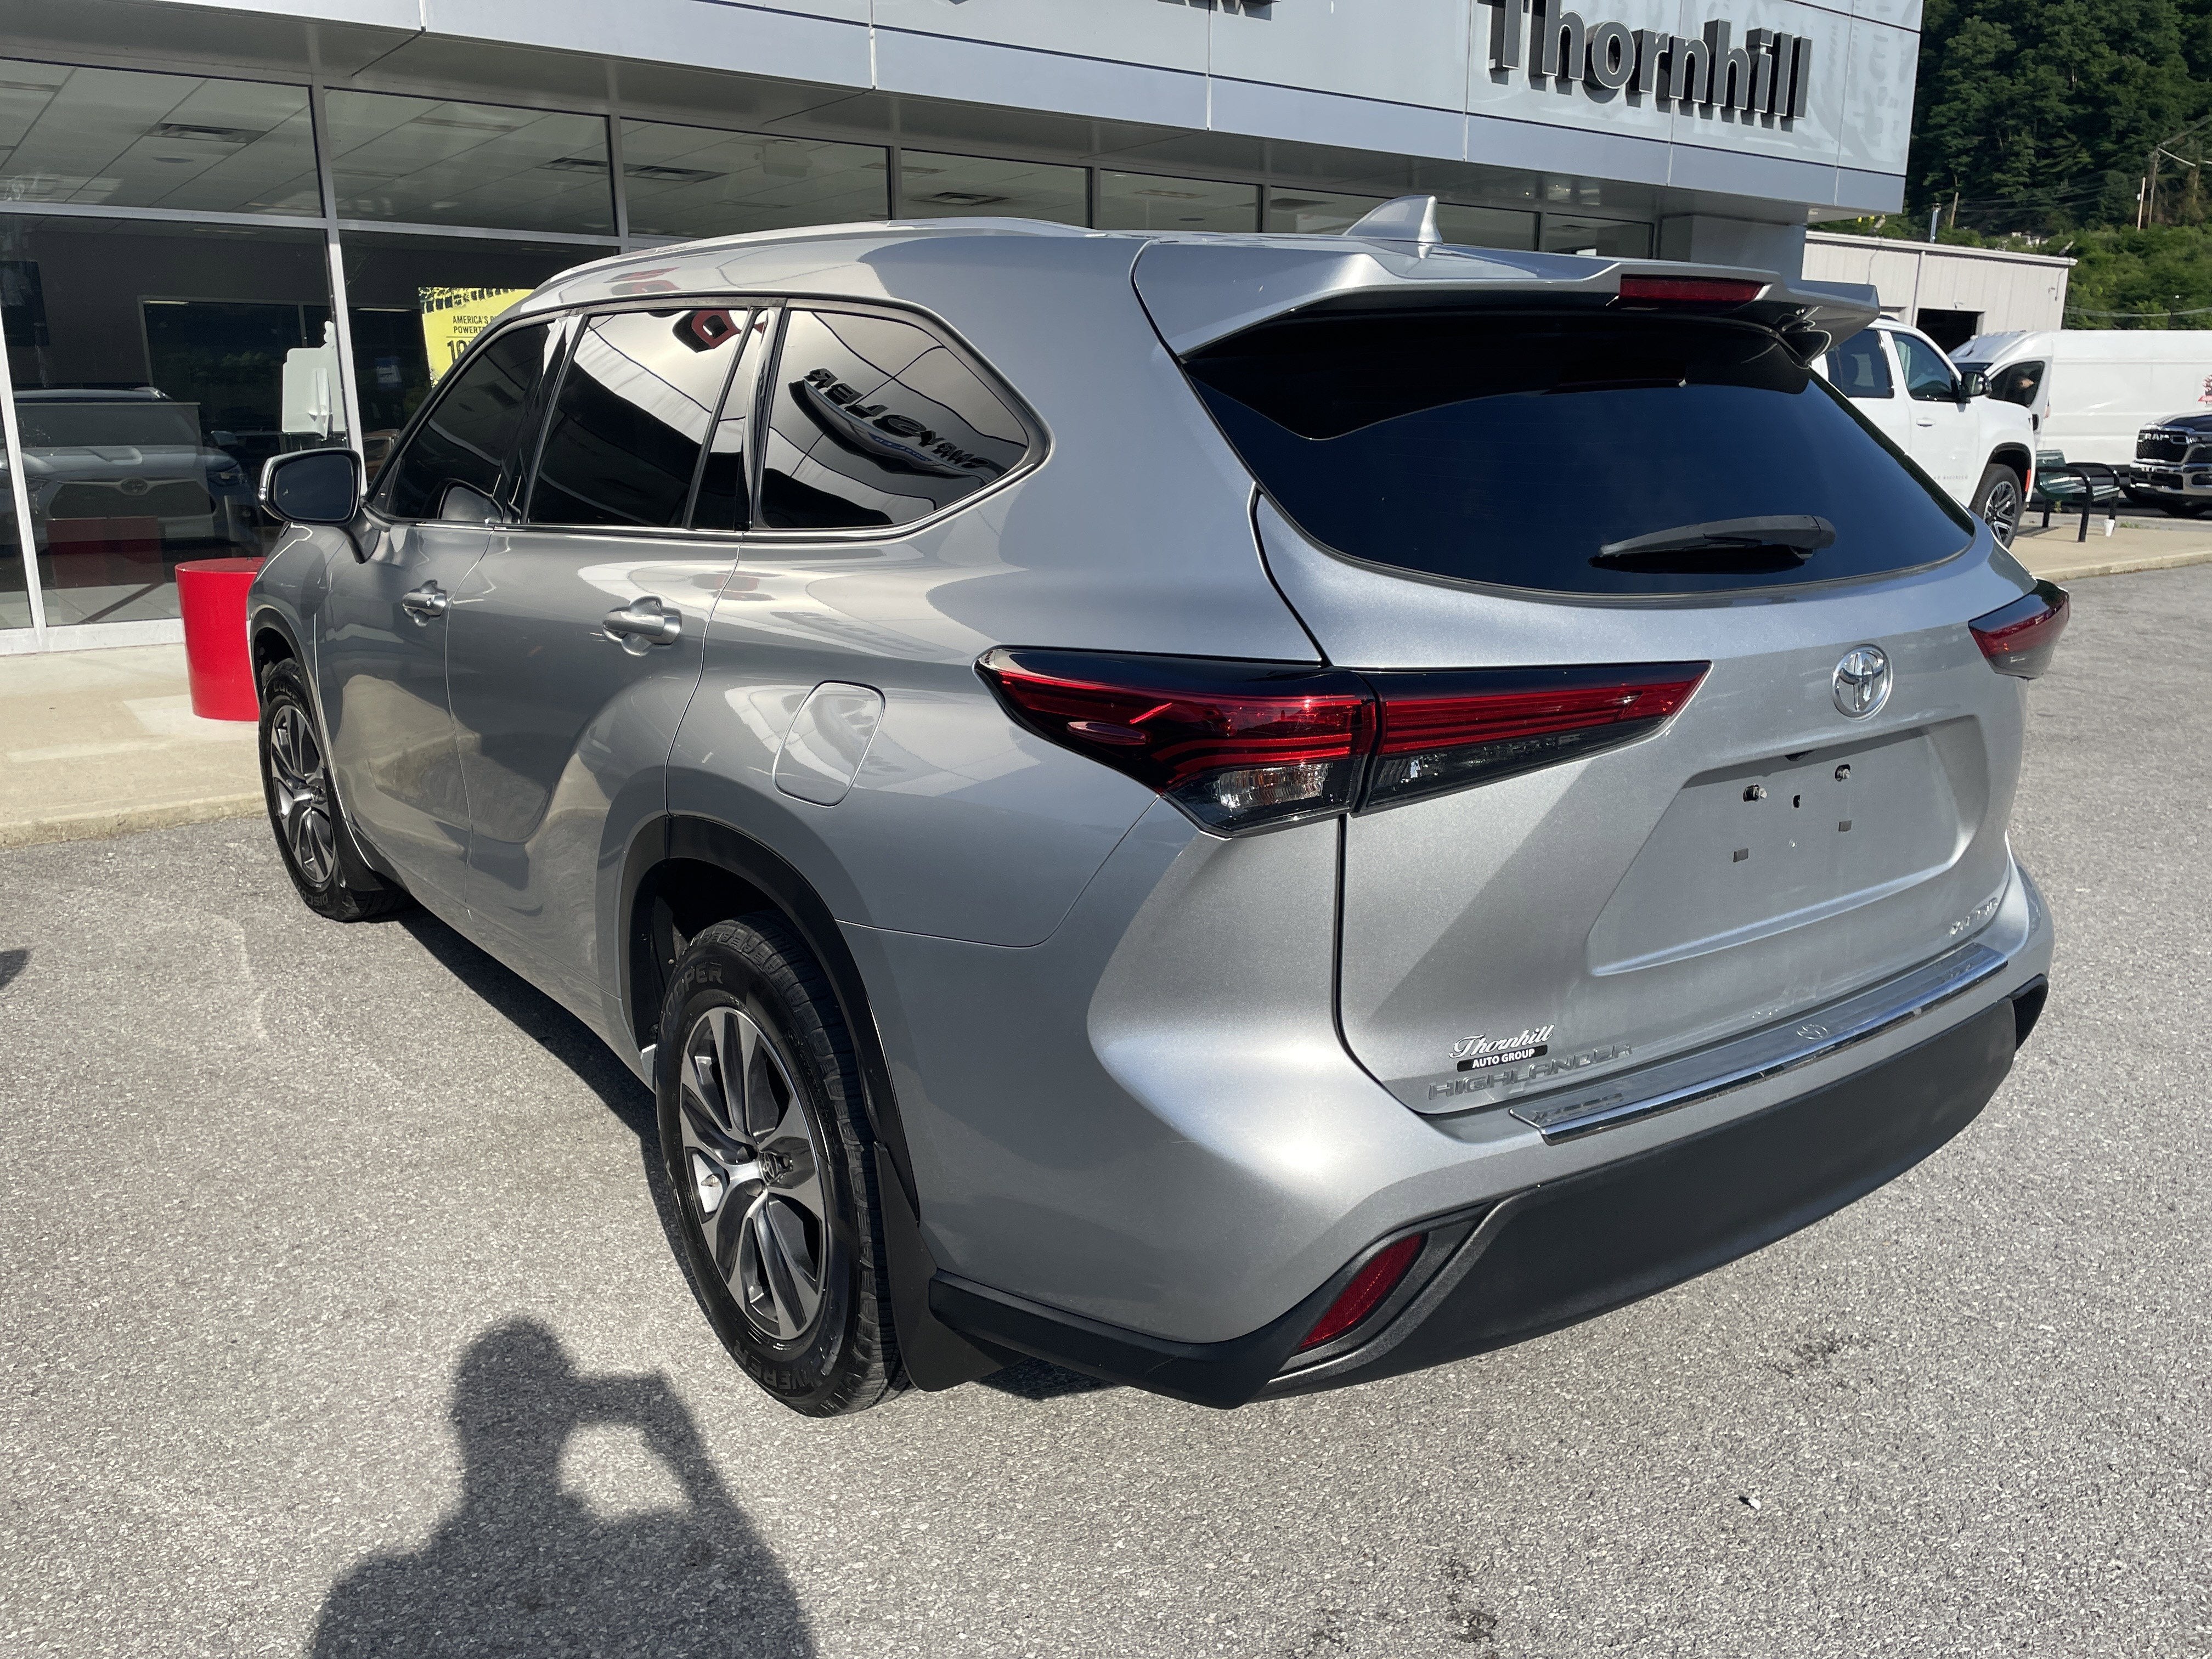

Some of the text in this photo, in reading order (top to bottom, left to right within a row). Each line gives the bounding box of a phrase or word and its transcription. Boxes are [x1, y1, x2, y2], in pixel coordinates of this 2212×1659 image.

[1478, 0, 1812, 120] Thornhill
[453, 315, 488, 324] AMERICA'S
[1448, 1024, 1555, 1059] Thornhill
[1472, 1048, 1535, 1069] AUTO GROUP
[1428, 1044, 1633, 1099] HIGHLANDER
